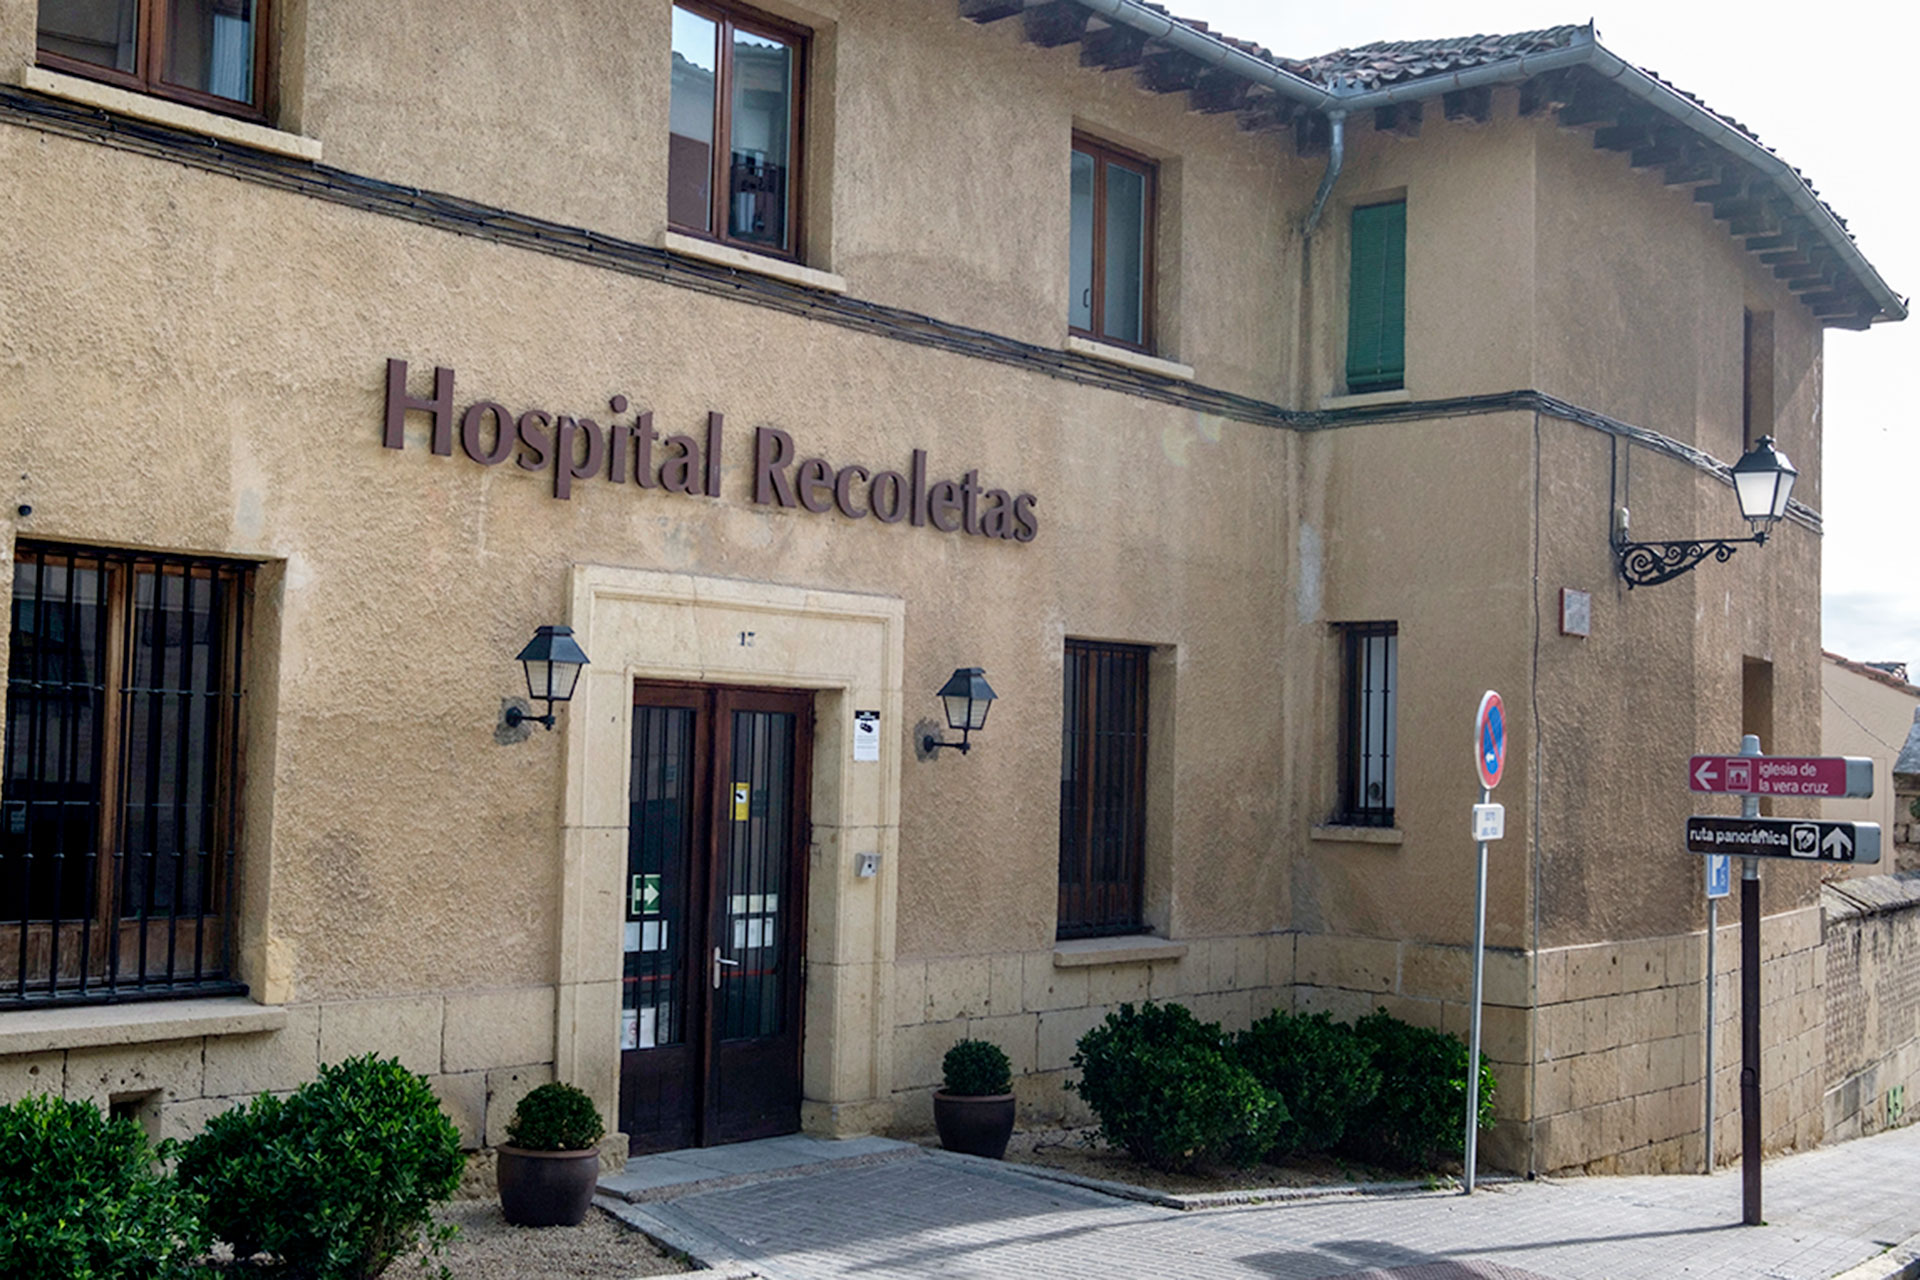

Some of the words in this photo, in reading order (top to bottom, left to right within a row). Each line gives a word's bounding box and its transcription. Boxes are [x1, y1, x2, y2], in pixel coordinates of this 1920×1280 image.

[382, 357, 724, 500] Hospital
[754, 425, 1038, 543] Recoletas
[1759, 762, 1798, 778] iglesia
[1800, 762, 1817, 777] de
[1759, 778, 1770, 793] la
[1772, 781, 1799, 793] vera
[1801, 782, 1829, 794] cruz
[1690, 827, 1714, 841] ruta
